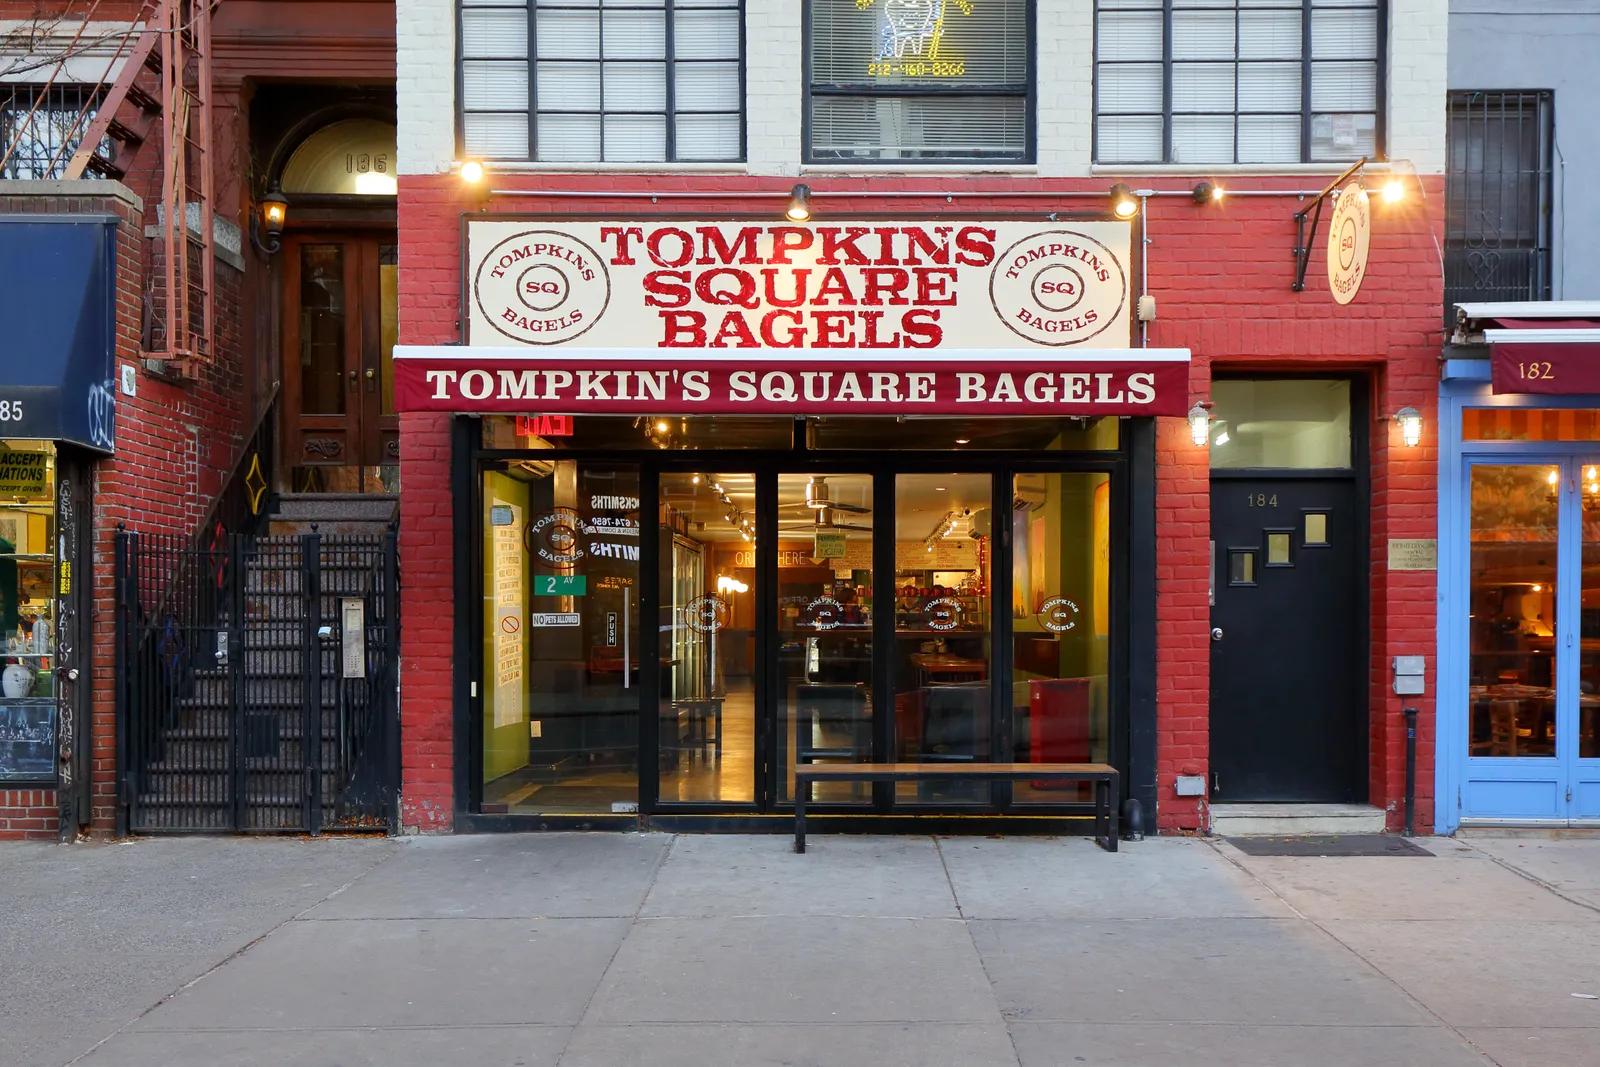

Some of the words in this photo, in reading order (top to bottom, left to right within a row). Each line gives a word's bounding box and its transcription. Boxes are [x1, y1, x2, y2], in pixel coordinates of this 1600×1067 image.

[346, 153, 388, 174] 186
[601, 225, 997, 268] TOMPKINS
[490, 243, 596, 282] TOMPKINS
[1005, 243, 1110, 282] TOMPKINS
[526, 281, 560, 295] SQ
[642, 266, 958, 309] SQUARE
[1041, 281, 1075, 295] SQ
[501, 307, 583, 332] BAGELS
[657, 309, 943, 348] BAGELS
[1016, 307, 1099, 333] BAGELS
[1519, 362, 1555, 380] 182
[426, 369, 711, 402] TOMPKIN'S
[729, 370, 937, 403] SQUARE
[955, 372, 1157, 404] BAGELS
[0, 452, 44, 465] ACCEPT
[1248, 493, 1278, 507] 184
[551, 534, 571, 542] SQ
[538, 548, 584, 562] BAGELS
[546, 576, 556, 593] 2
[1041, 599, 1080, 613] TOMPKINS
[533, 615, 545, 625] NO
